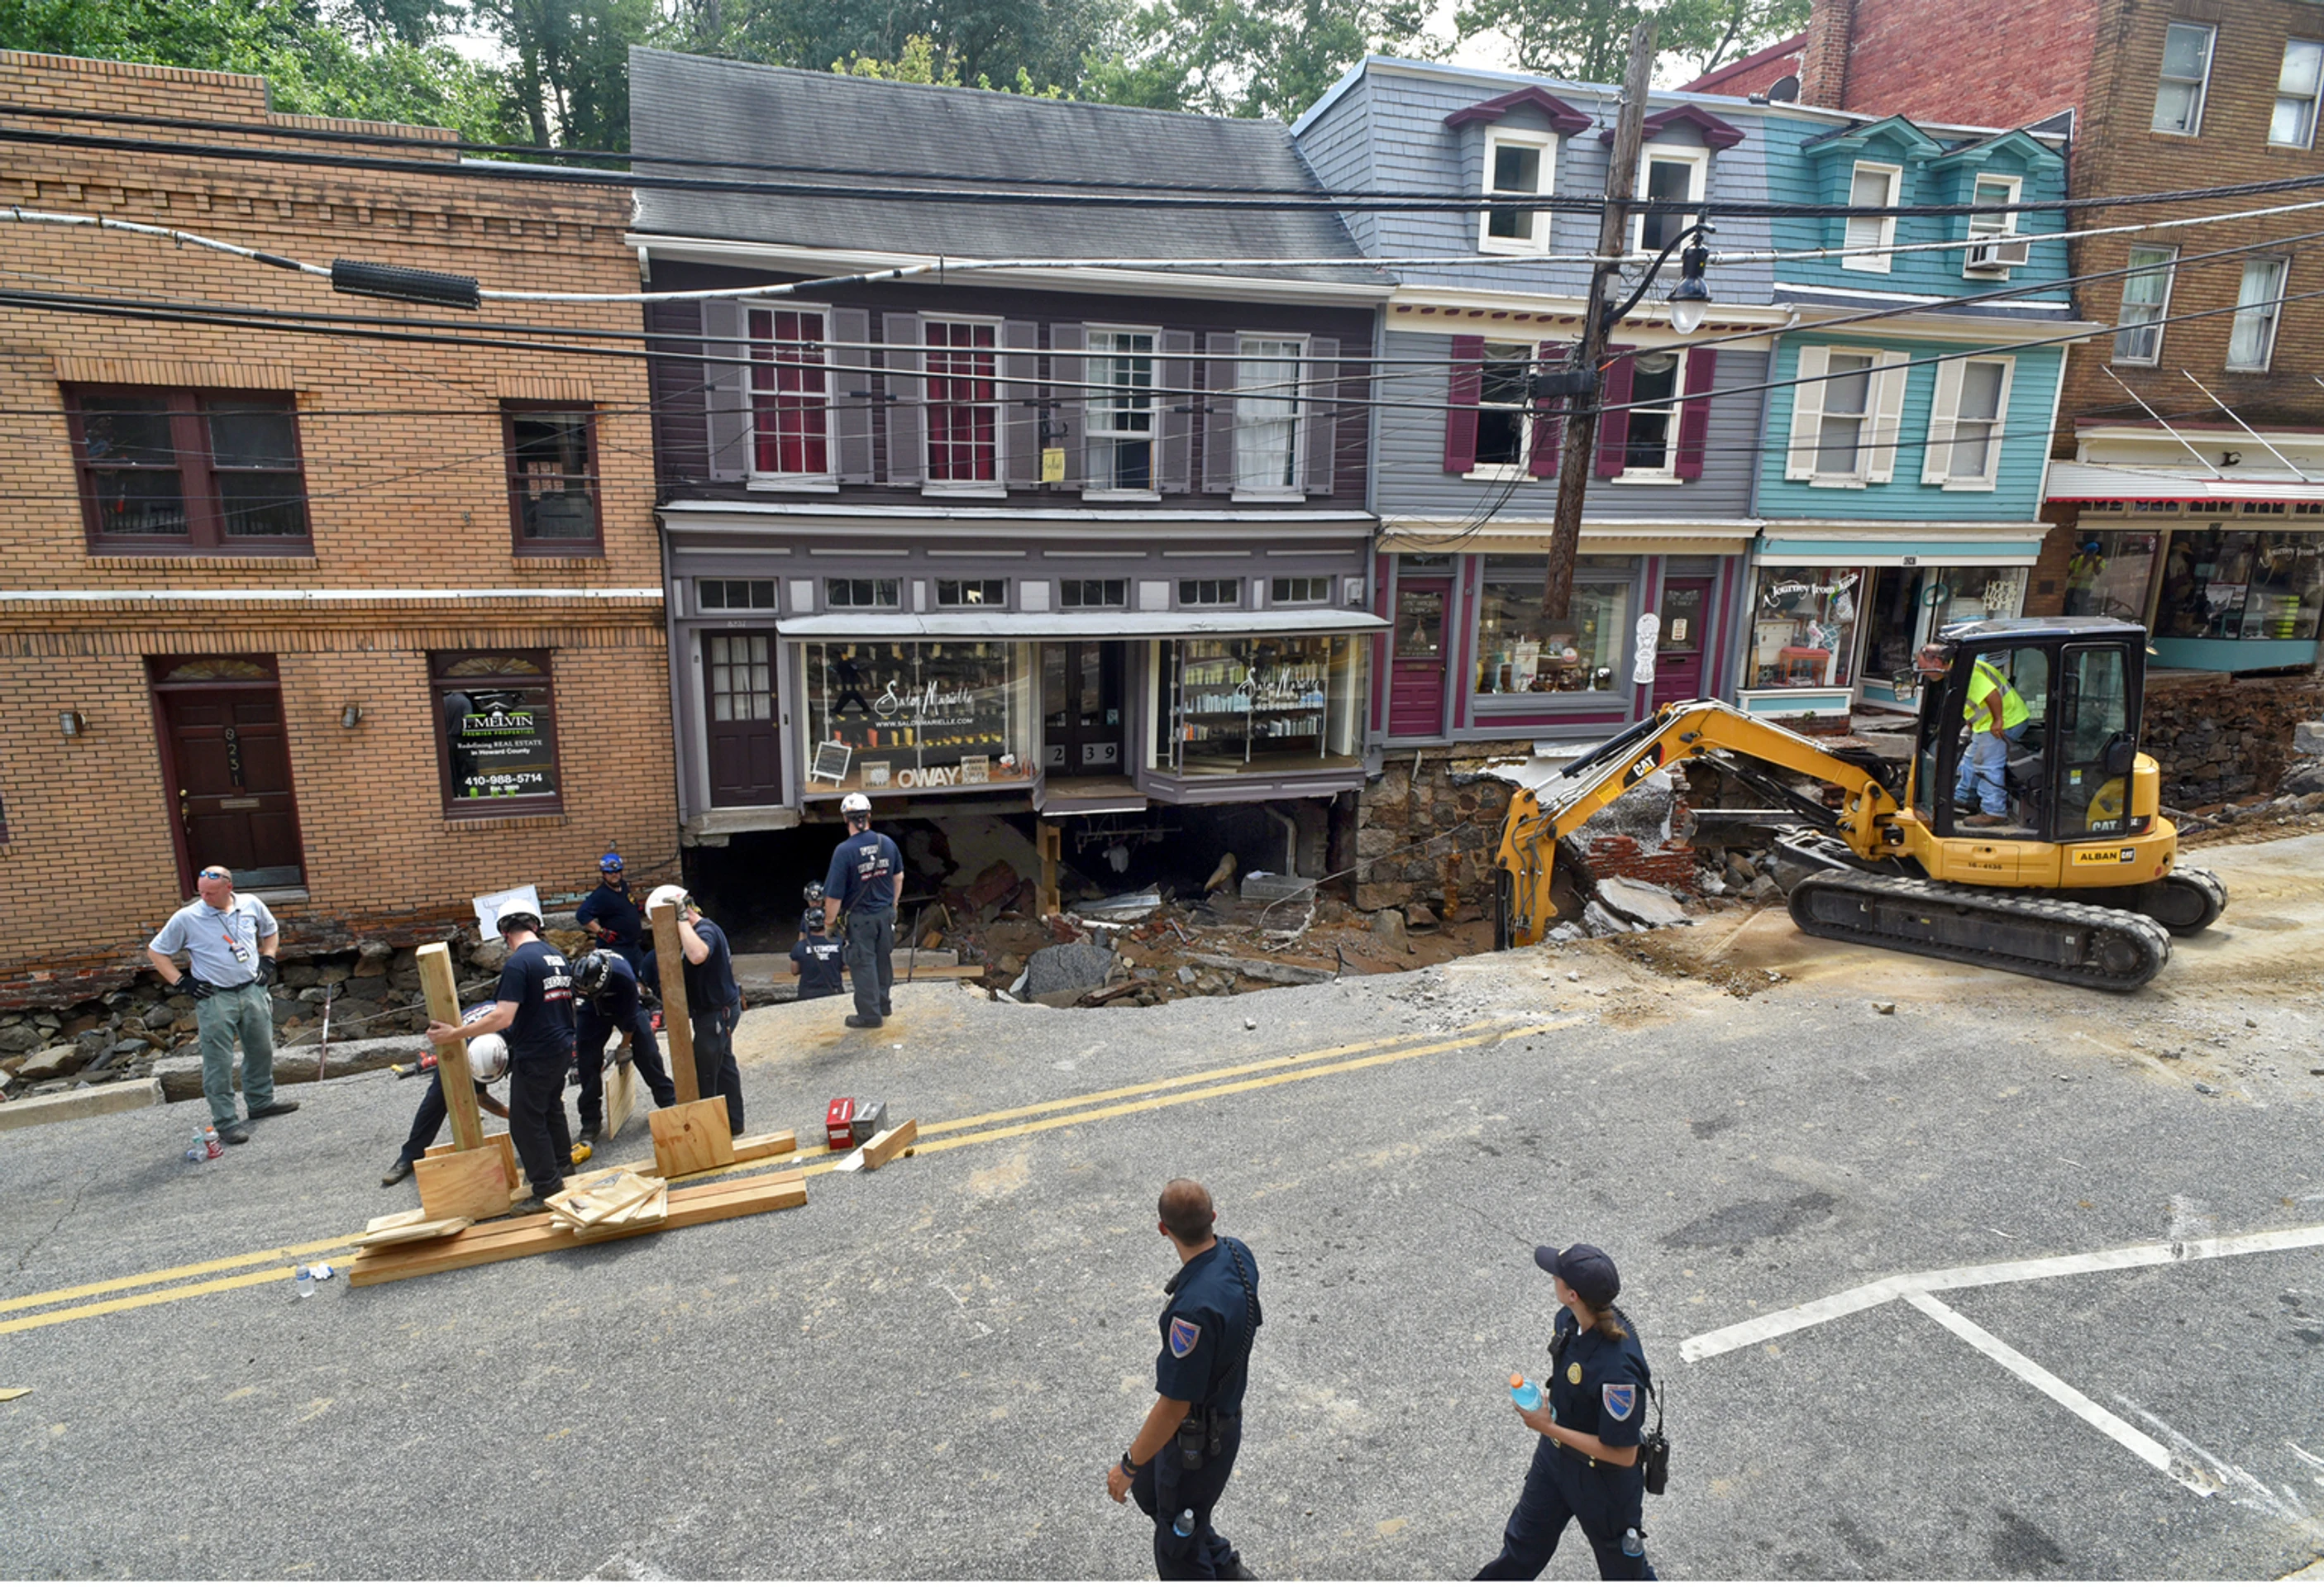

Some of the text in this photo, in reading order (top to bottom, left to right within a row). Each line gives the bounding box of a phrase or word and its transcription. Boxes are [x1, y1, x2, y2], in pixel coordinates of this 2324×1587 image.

[1771, 580, 1810, 600] Journey
[1811, 583, 1835, 598] from
[922, 680, 974, 716] Marielle
[475, 715, 533, 727] MELVIN
[875, 717, 974, 727] WWW.SALONMARIELLE.COM
[1633, 755, 1656, 777] CAT
[465, 773, 542, 786] 410-988-5714
[898, 765, 961, 788] OWAY
[2092, 820, 2117, 832] CAT
[2080, 851, 2133, 860] ALBAN CAT
